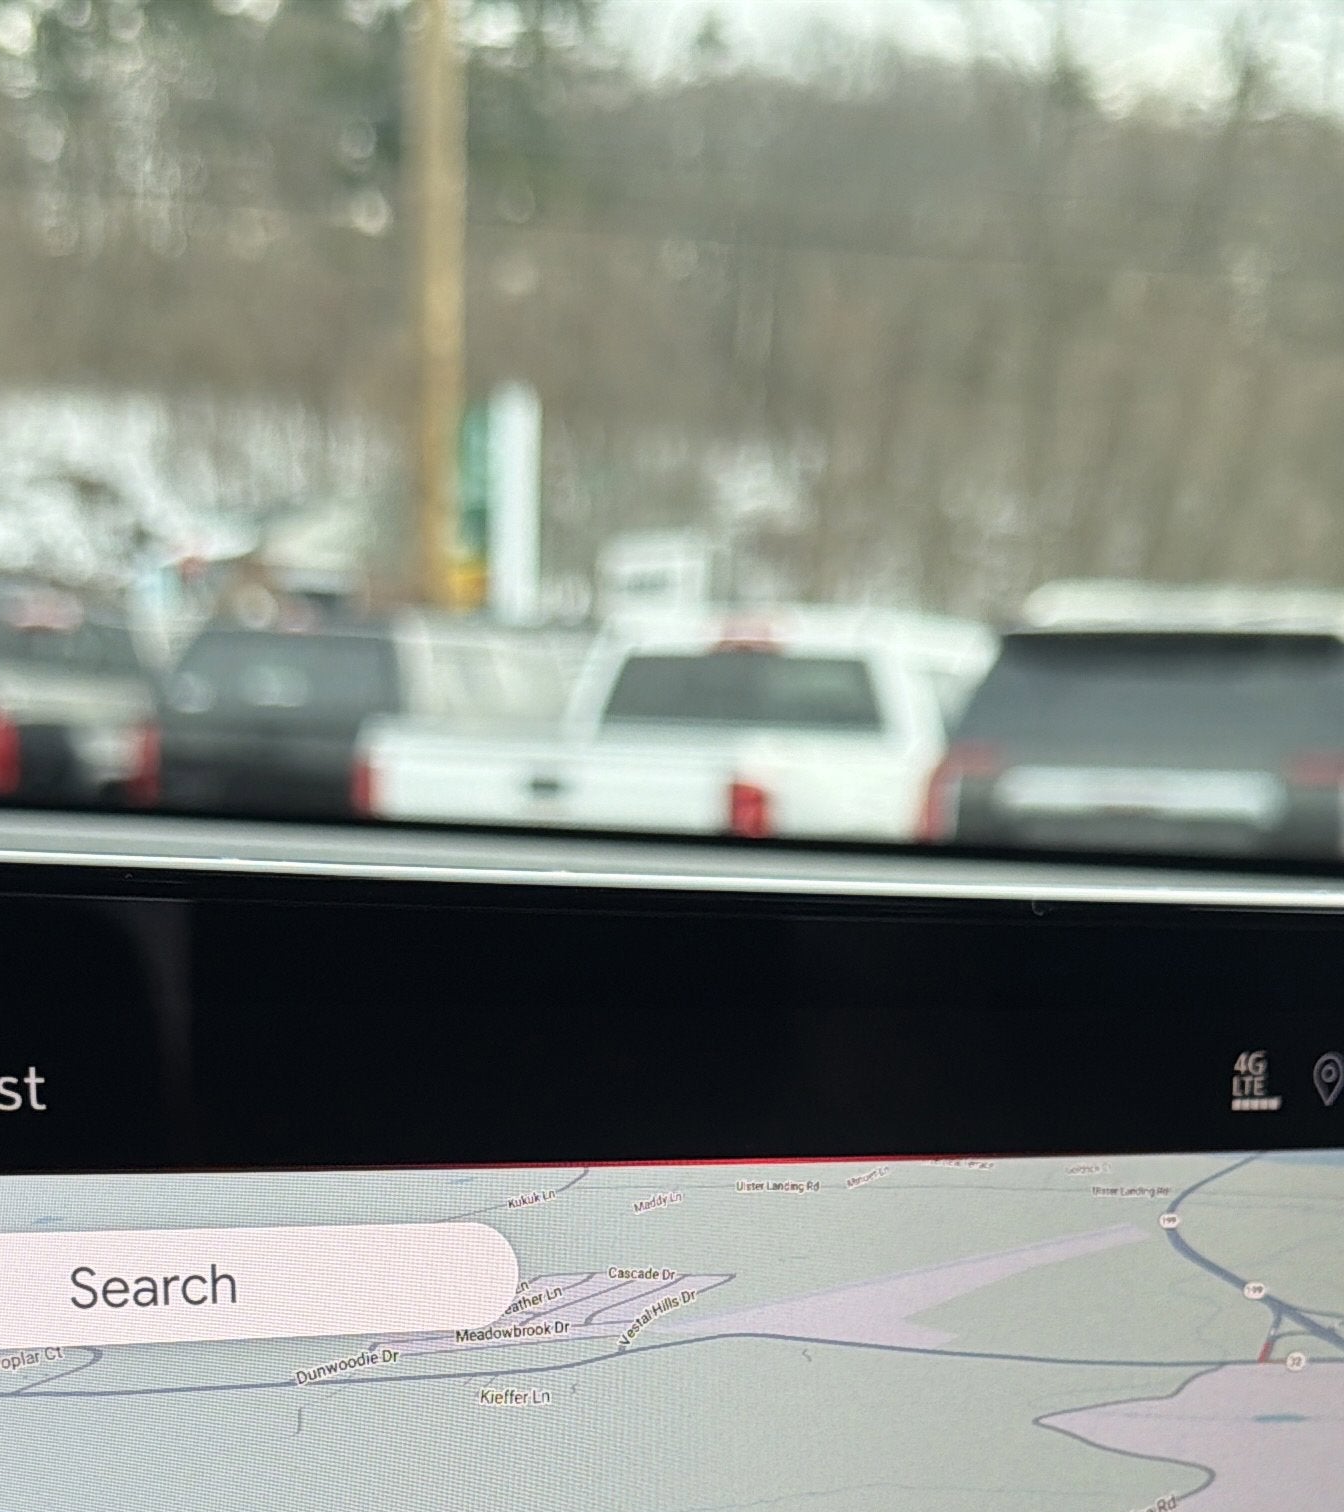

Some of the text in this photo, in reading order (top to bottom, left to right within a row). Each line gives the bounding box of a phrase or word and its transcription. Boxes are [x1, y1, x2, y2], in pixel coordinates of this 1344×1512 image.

[1234, 1051, 1268, 1076] 4G
[1232, 1076, 1266, 1097] LTE
[736, 1180, 821, 1194] Ulster Landing Rd
[507, 1190, 556, 1209] Kukuk Ln
[633, 1194, 666, 1214] Maddy
[608, 1266, 676, 1280] Cascade Dr
[69, 1263, 239, 1310] Search
[502, 1287, 563, 1317] eather Ln
[618, 1288, 697, 1346] Vestal Hills Dr
[456, 1320, 570, 1343] Meadowbrook Dr
[45, 1346, 64, 1361] Ct
[296, 1348, 399, 1385] Dunwoodie Dr
[480, 1388, 551, 1404] Kieffer Ln
